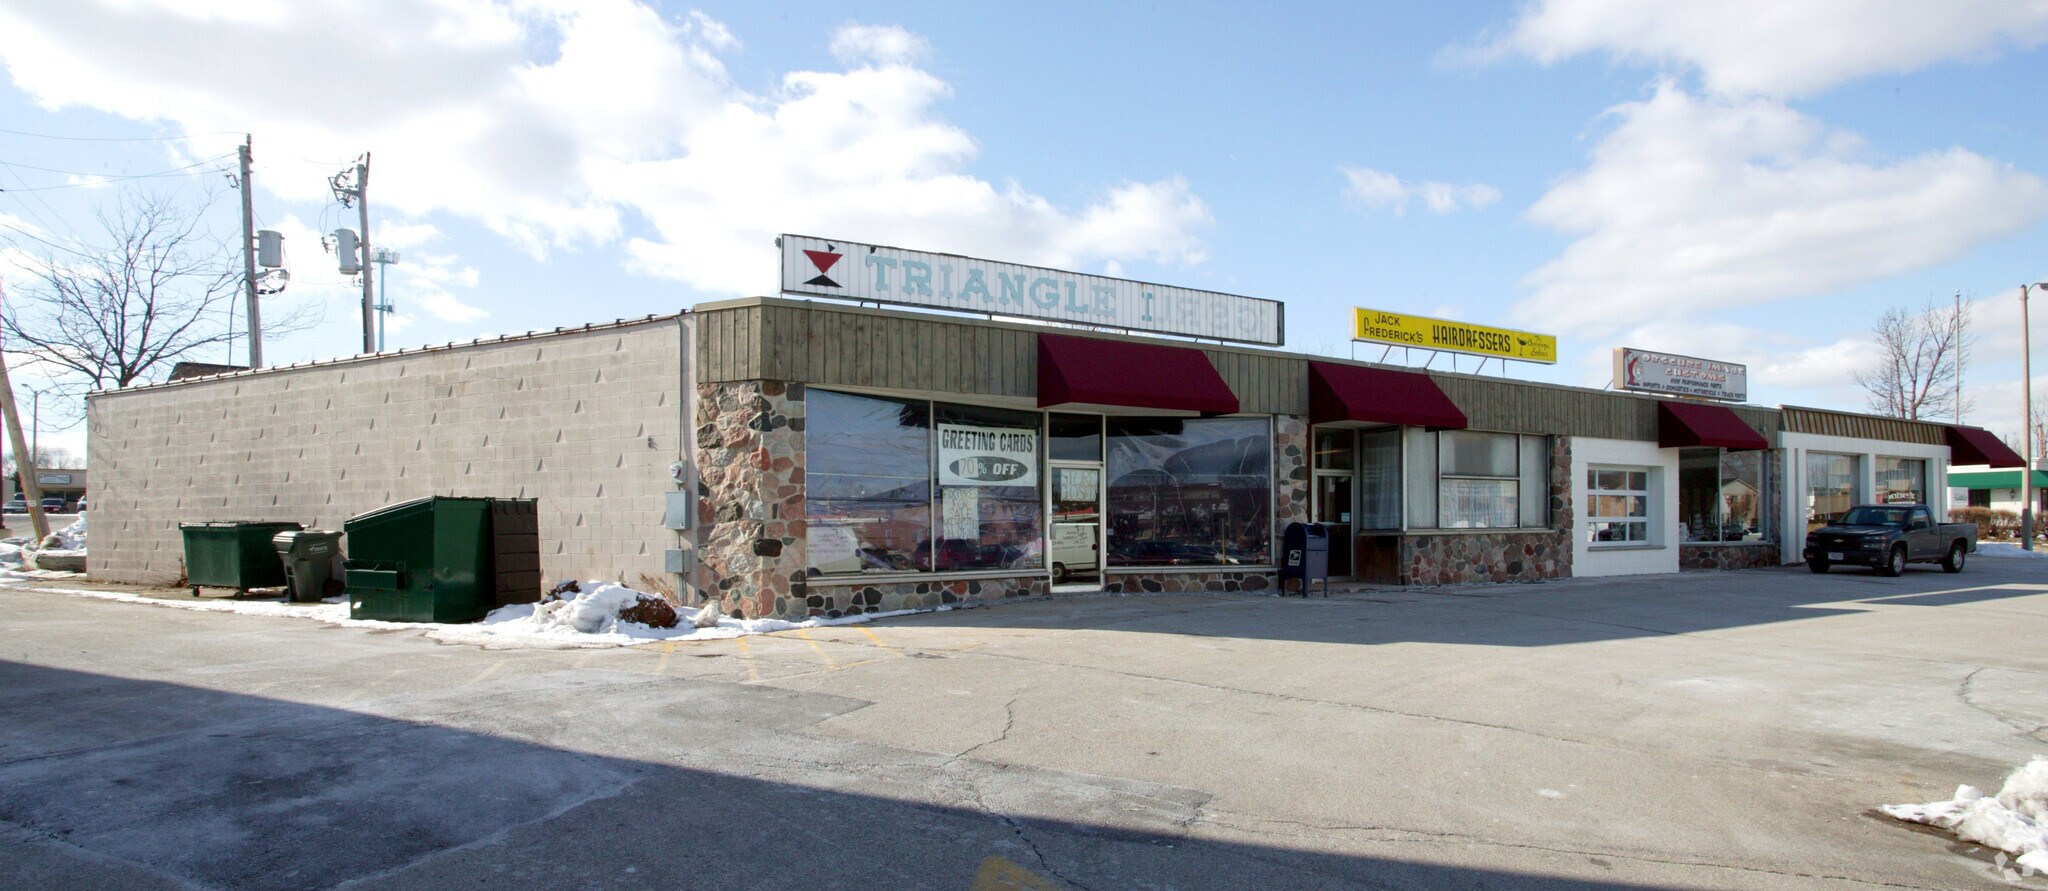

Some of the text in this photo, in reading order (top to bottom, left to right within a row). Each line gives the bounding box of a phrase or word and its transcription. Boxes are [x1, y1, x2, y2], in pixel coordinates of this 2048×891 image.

[866, 253, 1117, 317] TRIANGLE
[1364, 317, 1423, 343] FREDERICK'S
[1375, 312, 1400, 327] JACK
[1432, 324, 1511, 353] HAIRDRESSERS
[1641, 352, 1745, 376] OBSCURE IMAGE
[1665, 367, 1726, 382] CUSTOMS
[942, 428, 1033, 453] GREETING CARDS
[992, 463, 1018, 476] OFF
